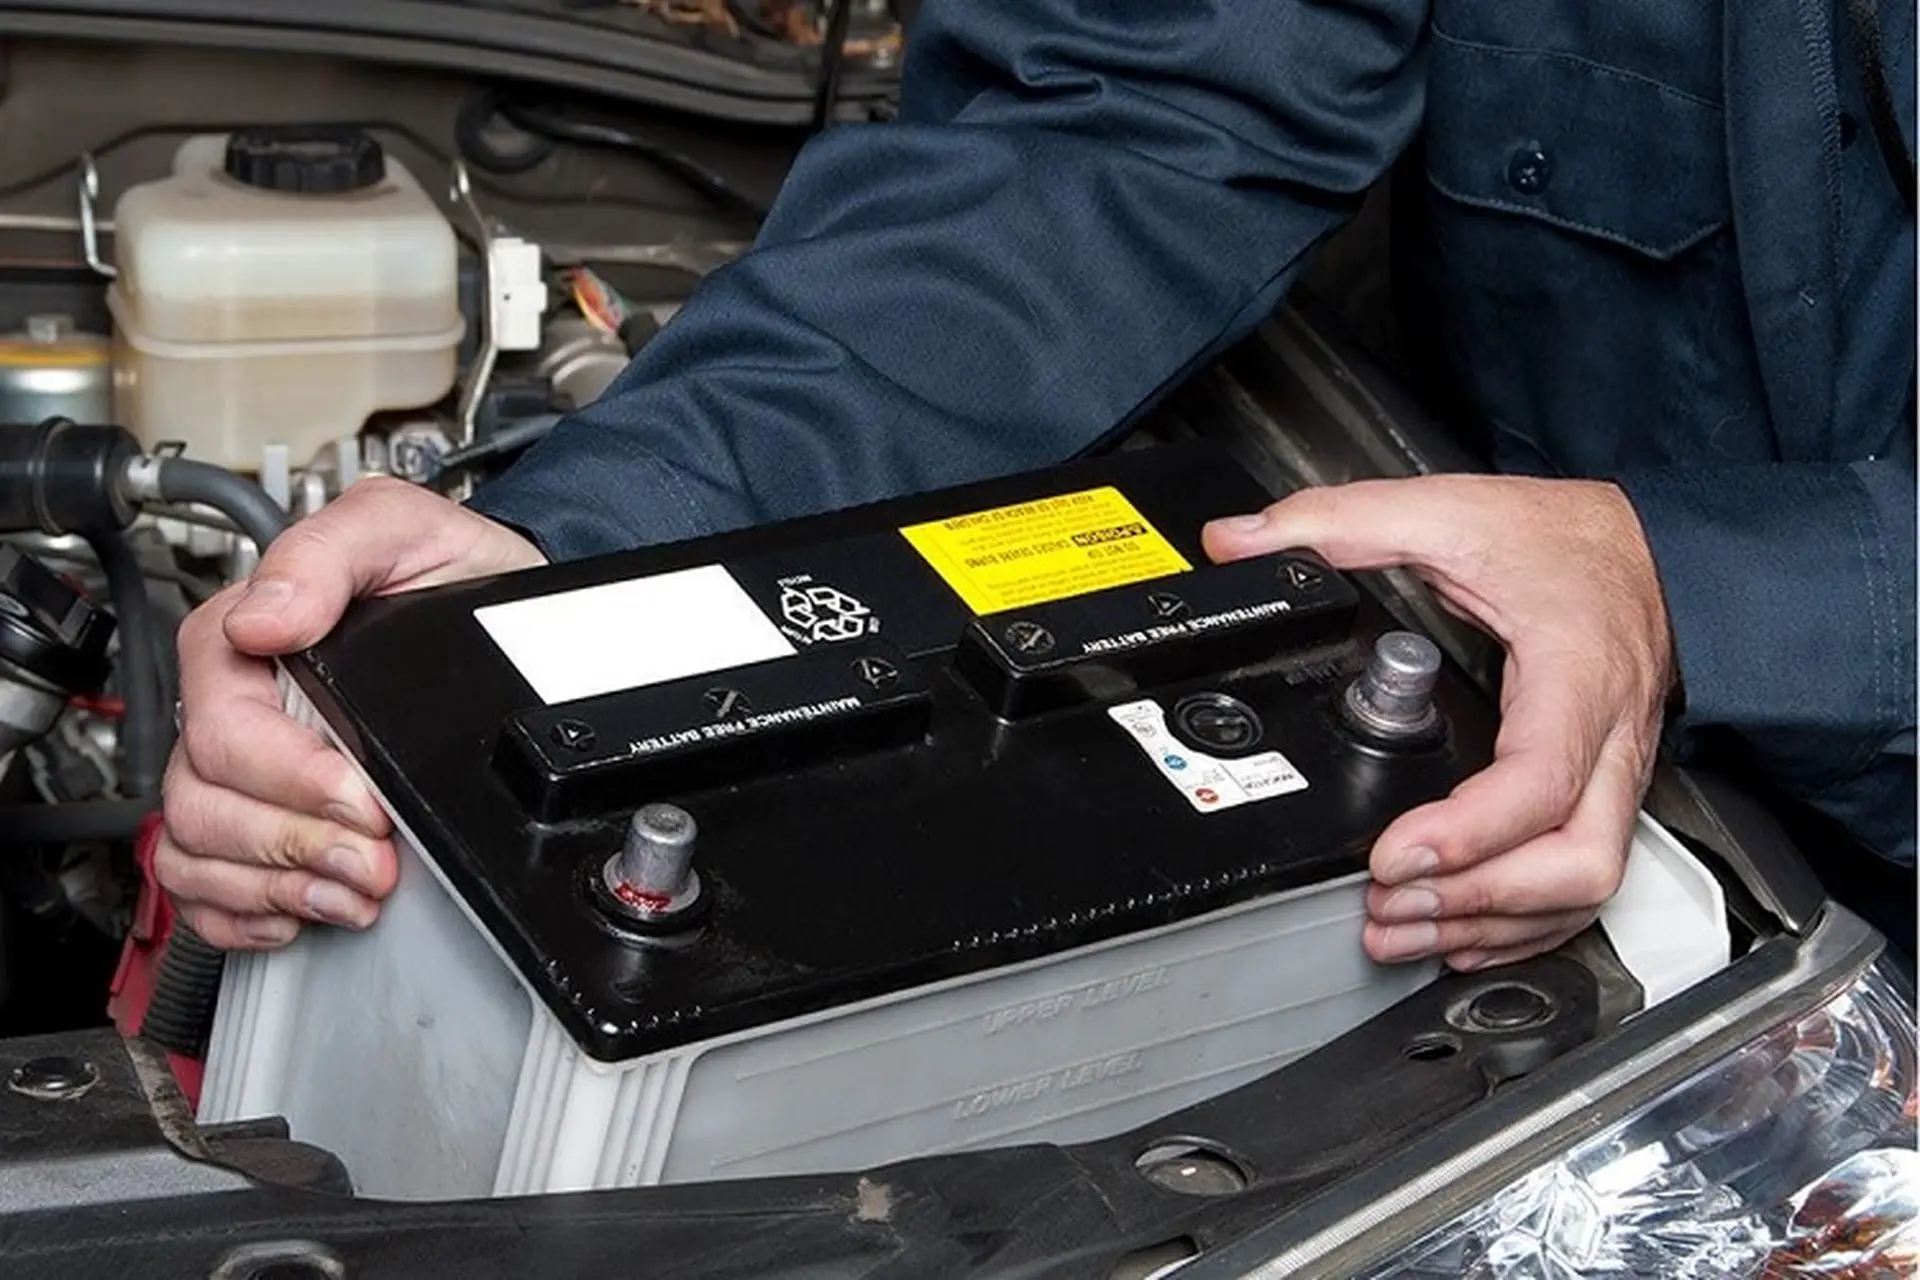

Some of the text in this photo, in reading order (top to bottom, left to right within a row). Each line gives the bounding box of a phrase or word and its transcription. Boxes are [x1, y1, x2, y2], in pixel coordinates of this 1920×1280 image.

[1082, 600, 1291, 654] MAINTENANCE FREE BATTERY
[629, 697, 861, 754] MAINTENANCE FREE BATTERY
[983, 966, 1173, 1038] UPPER LEVEL
[953, 1050, 1144, 1122] LOWER LEVEL
